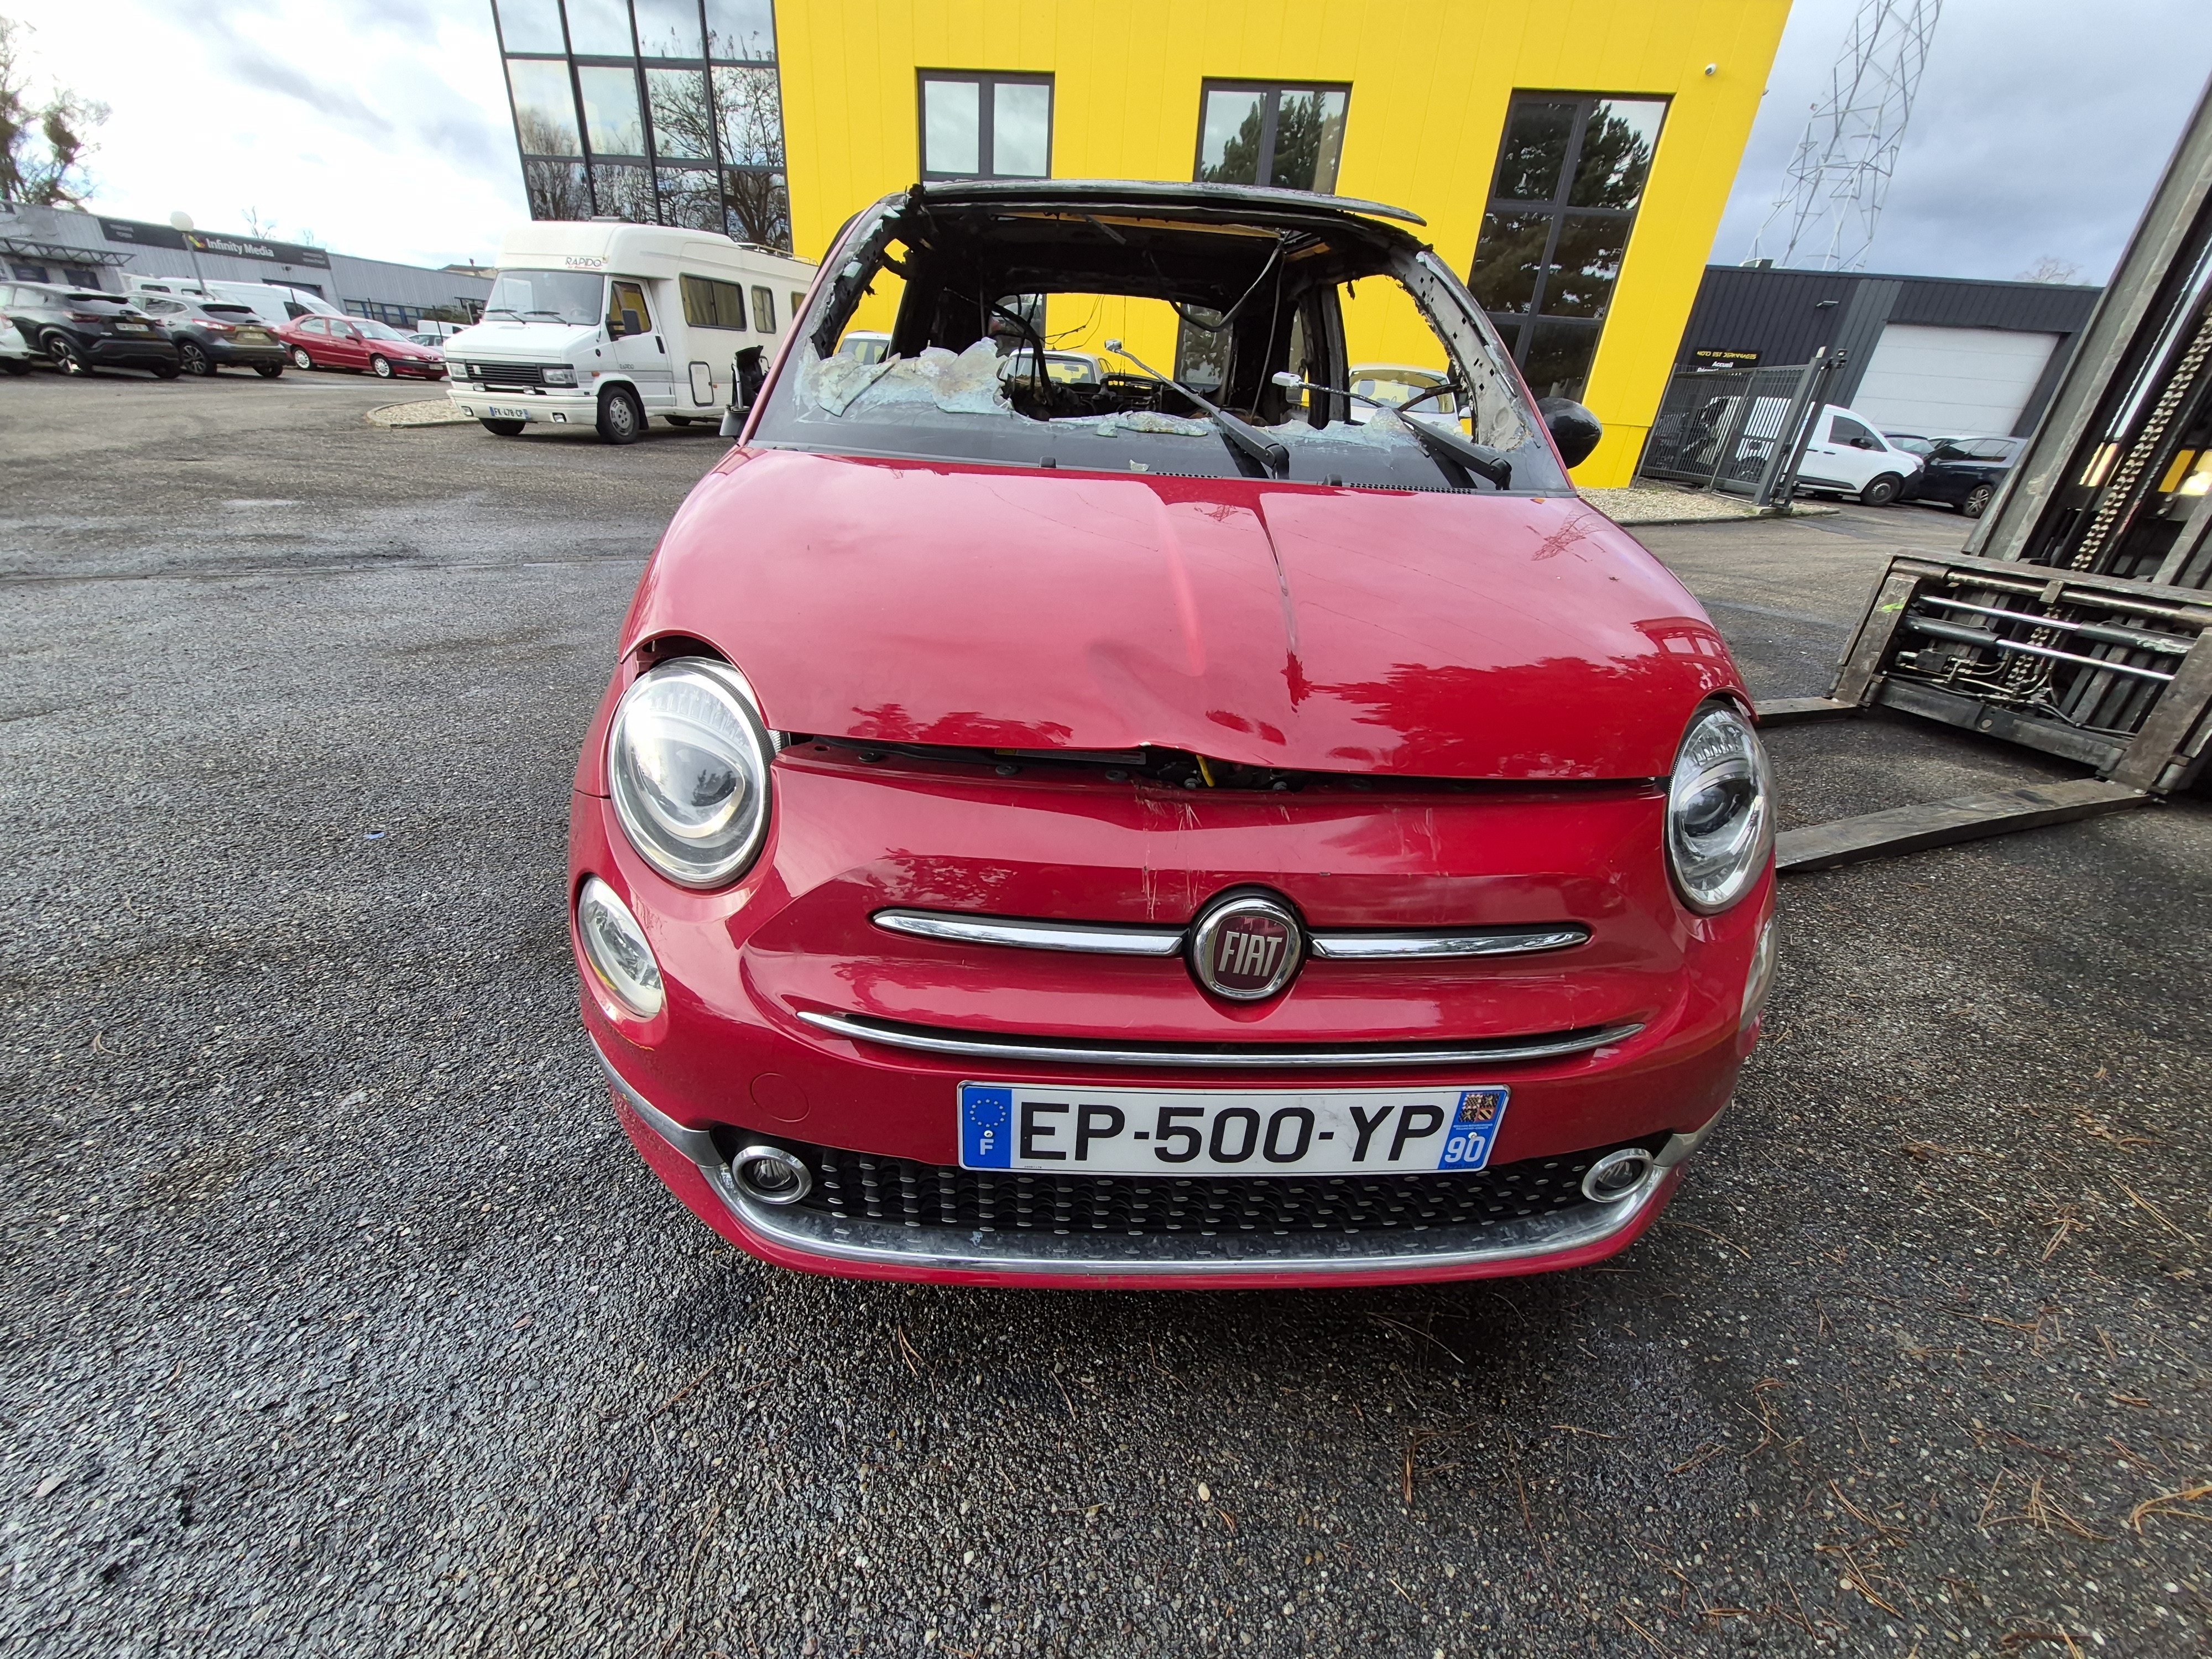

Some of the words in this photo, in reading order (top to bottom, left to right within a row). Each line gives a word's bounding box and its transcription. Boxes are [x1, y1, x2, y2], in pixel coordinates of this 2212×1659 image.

[206, 238, 242, 254] Infinity
[243, 244, 275, 257] Media
[565, 257, 602, 267] RAPIDO
[1218, 931, 1283, 977] FIAT
[1020, 1101, 1444, 1164] EP-500-YP
[980, 1139, 994, 1155] F
[1444, 1136, 1485, 1162] 90
